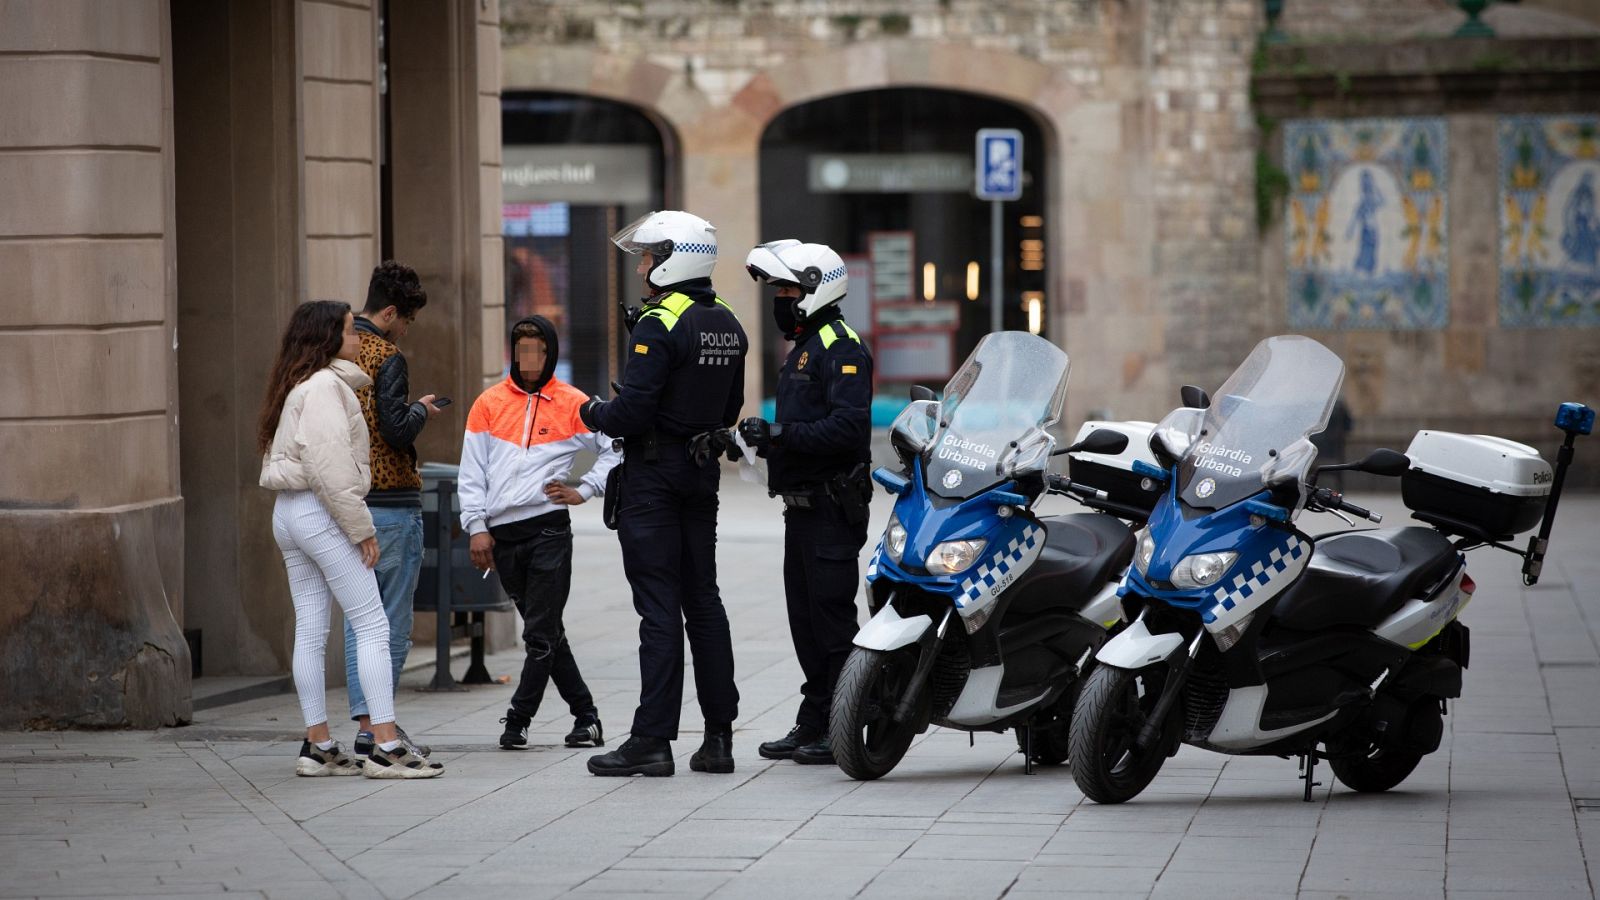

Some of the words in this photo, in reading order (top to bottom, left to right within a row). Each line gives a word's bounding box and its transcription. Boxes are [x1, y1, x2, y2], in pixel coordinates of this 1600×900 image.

[700, 332, 740, 347] POLICIA
[943, 433, 997, 459] Guàrdia
[1200, 440, 1253, 465] Guàrdia
[938, 447, 988, 472] Urbana
[1193, 456, 1243, 478] Urbana
[990, 573, 1014, 596] GU-518
